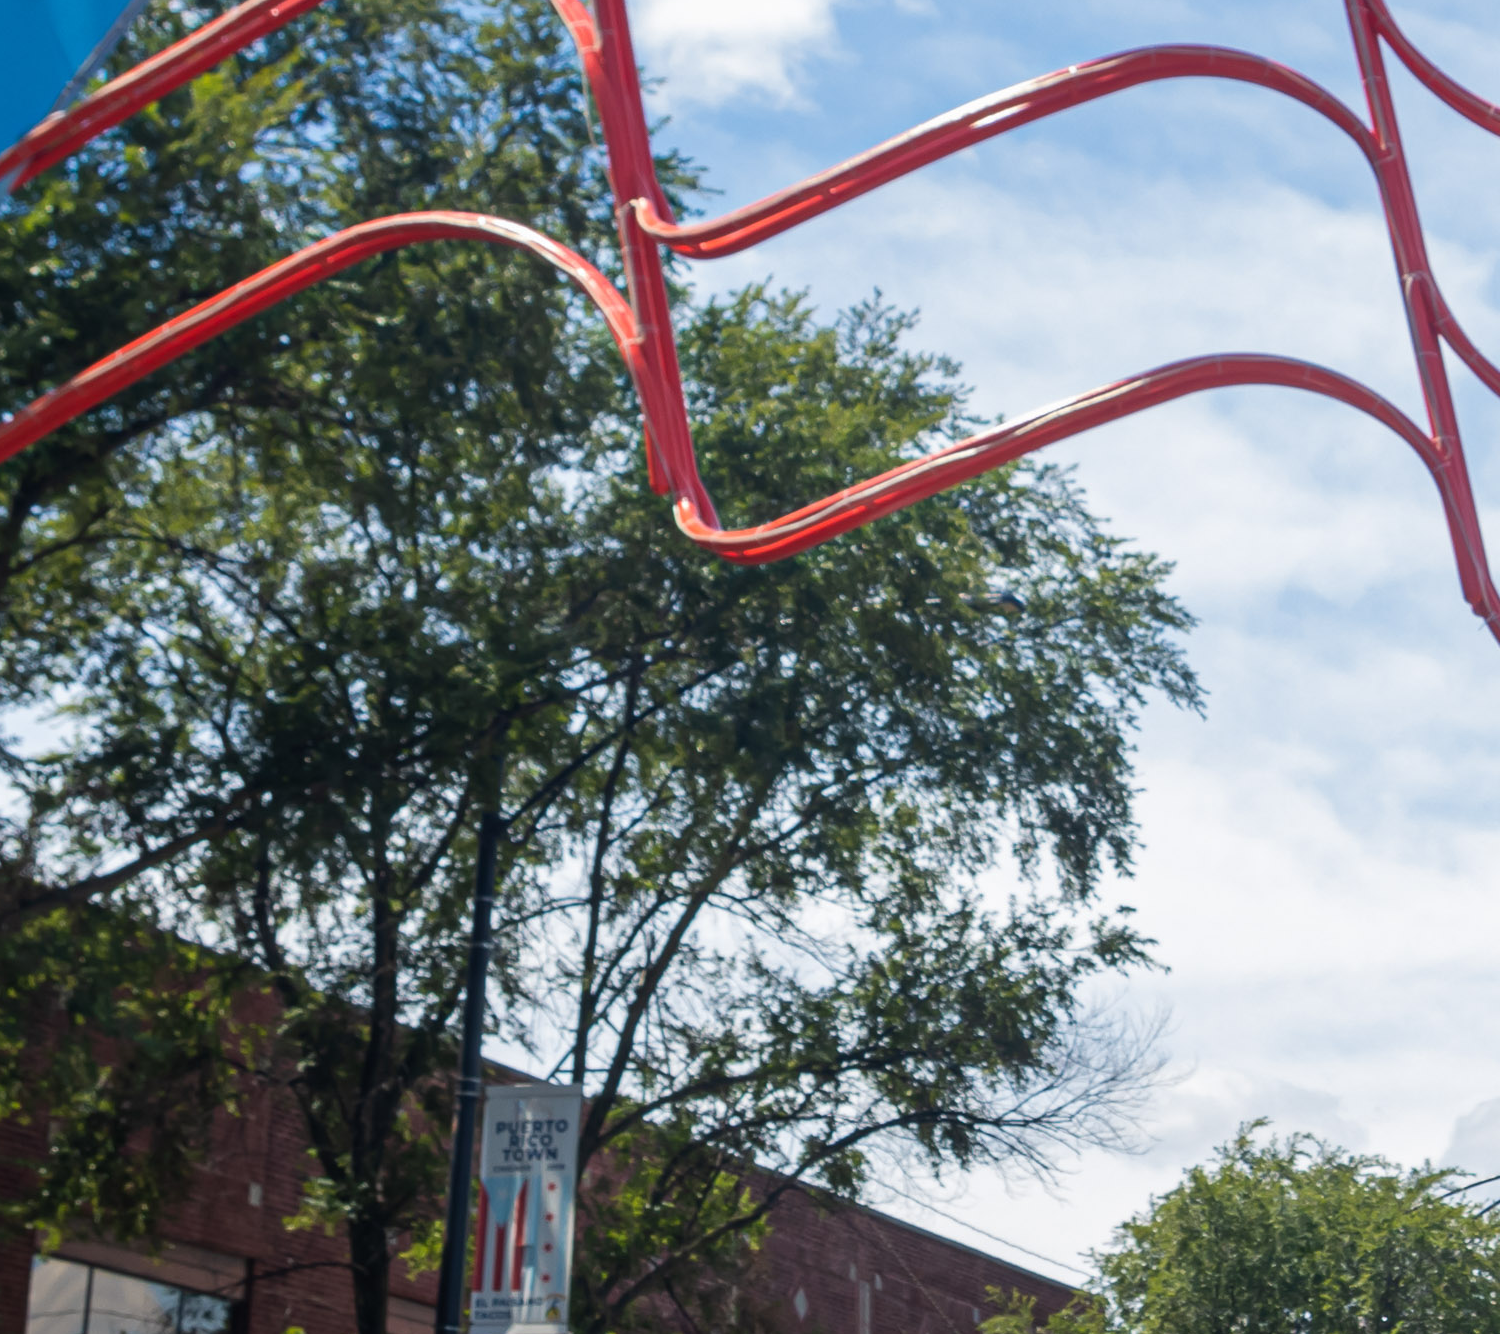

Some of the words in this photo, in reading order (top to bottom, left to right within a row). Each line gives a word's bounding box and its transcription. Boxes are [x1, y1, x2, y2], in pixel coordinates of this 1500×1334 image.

[496, 1118, 568, 1134] PUERTO
[509, 1134, 552, 1147] RICO
[502, 1148, 558, 1161] TOWN
